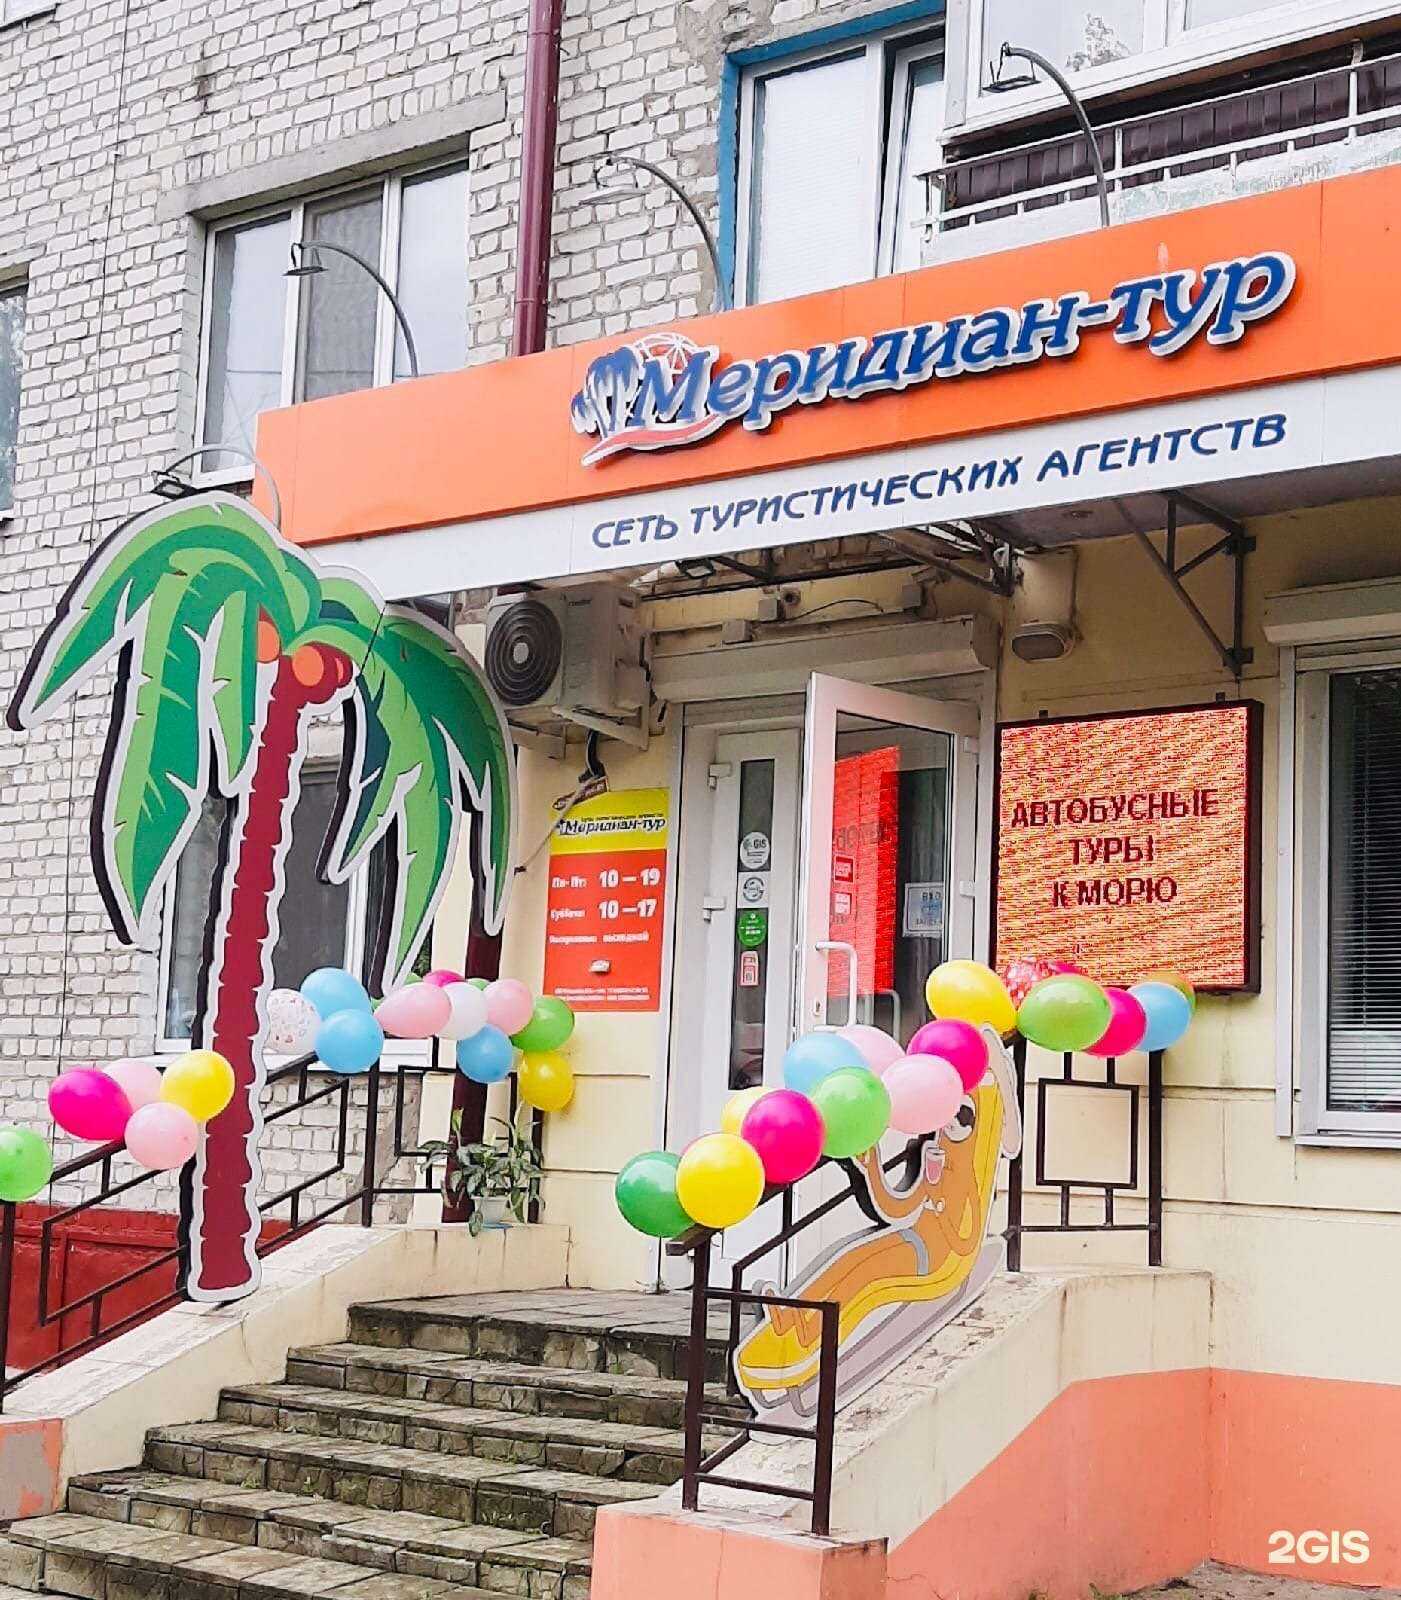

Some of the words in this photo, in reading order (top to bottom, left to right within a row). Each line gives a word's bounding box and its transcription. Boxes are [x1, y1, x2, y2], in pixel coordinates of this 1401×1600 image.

[626, 253, 1292, 428] Меридиан-тур
[592, 514, 679, 548] СЕТЬ
[690, 455, 1024, 534] ТУРИСТИЧЕСКИХ
[1036, 413, 1287, 482] АГЕНТСТВ
[1012, 788, 1219, 828] АВТОБУСНЫЕ
[1068, 834, 1155, 866] ТУРЫ
[1052, 880, 1069, 907] К
[1075, 876, 1178, 906] МОРЮ
